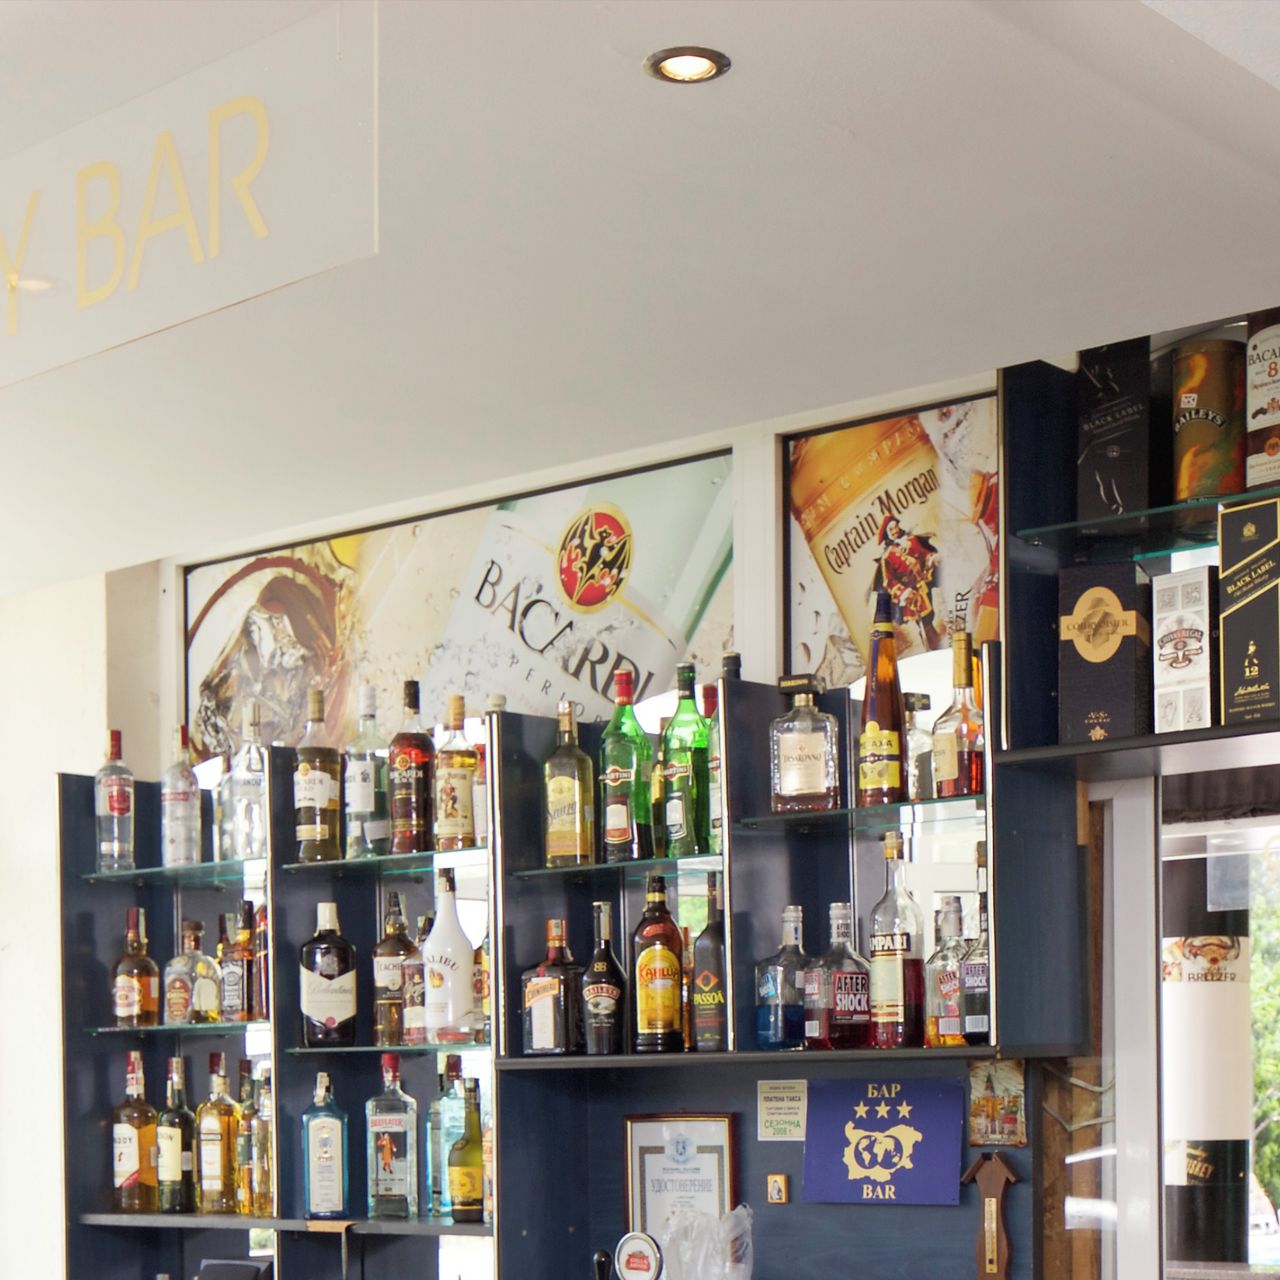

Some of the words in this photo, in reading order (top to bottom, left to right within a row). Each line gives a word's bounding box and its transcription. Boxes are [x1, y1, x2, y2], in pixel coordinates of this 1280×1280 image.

[75, 95, 270, 311] BAR
[1175, 407, 1224, 432] BAILEYS
[824, 511, 880, 575] Captain
[871, 467, 941, 516] Morgan
[1226, 574, 1250, 594] BLACK
[1251, 559, 1276, 578] LABEL
[475, 559, 655, 706] BACARDI
[1243, 665, 1259, 678] 12
[870, 934, 908, 951] MPARI
[965, 965, 986, 976] AFTER
[836, 976, 868, 992] AFTER
[965, 976, 987, 988] SHOCK
[836, 994, 868, 1011] SHOCK
[867, 1083, 901, 1098] БАР
[370, 1118, 404, 1127] BEEFEATER
[114, 1136, 133, 1144] ADDY
[862, 1184, 896, 1199] BAR
